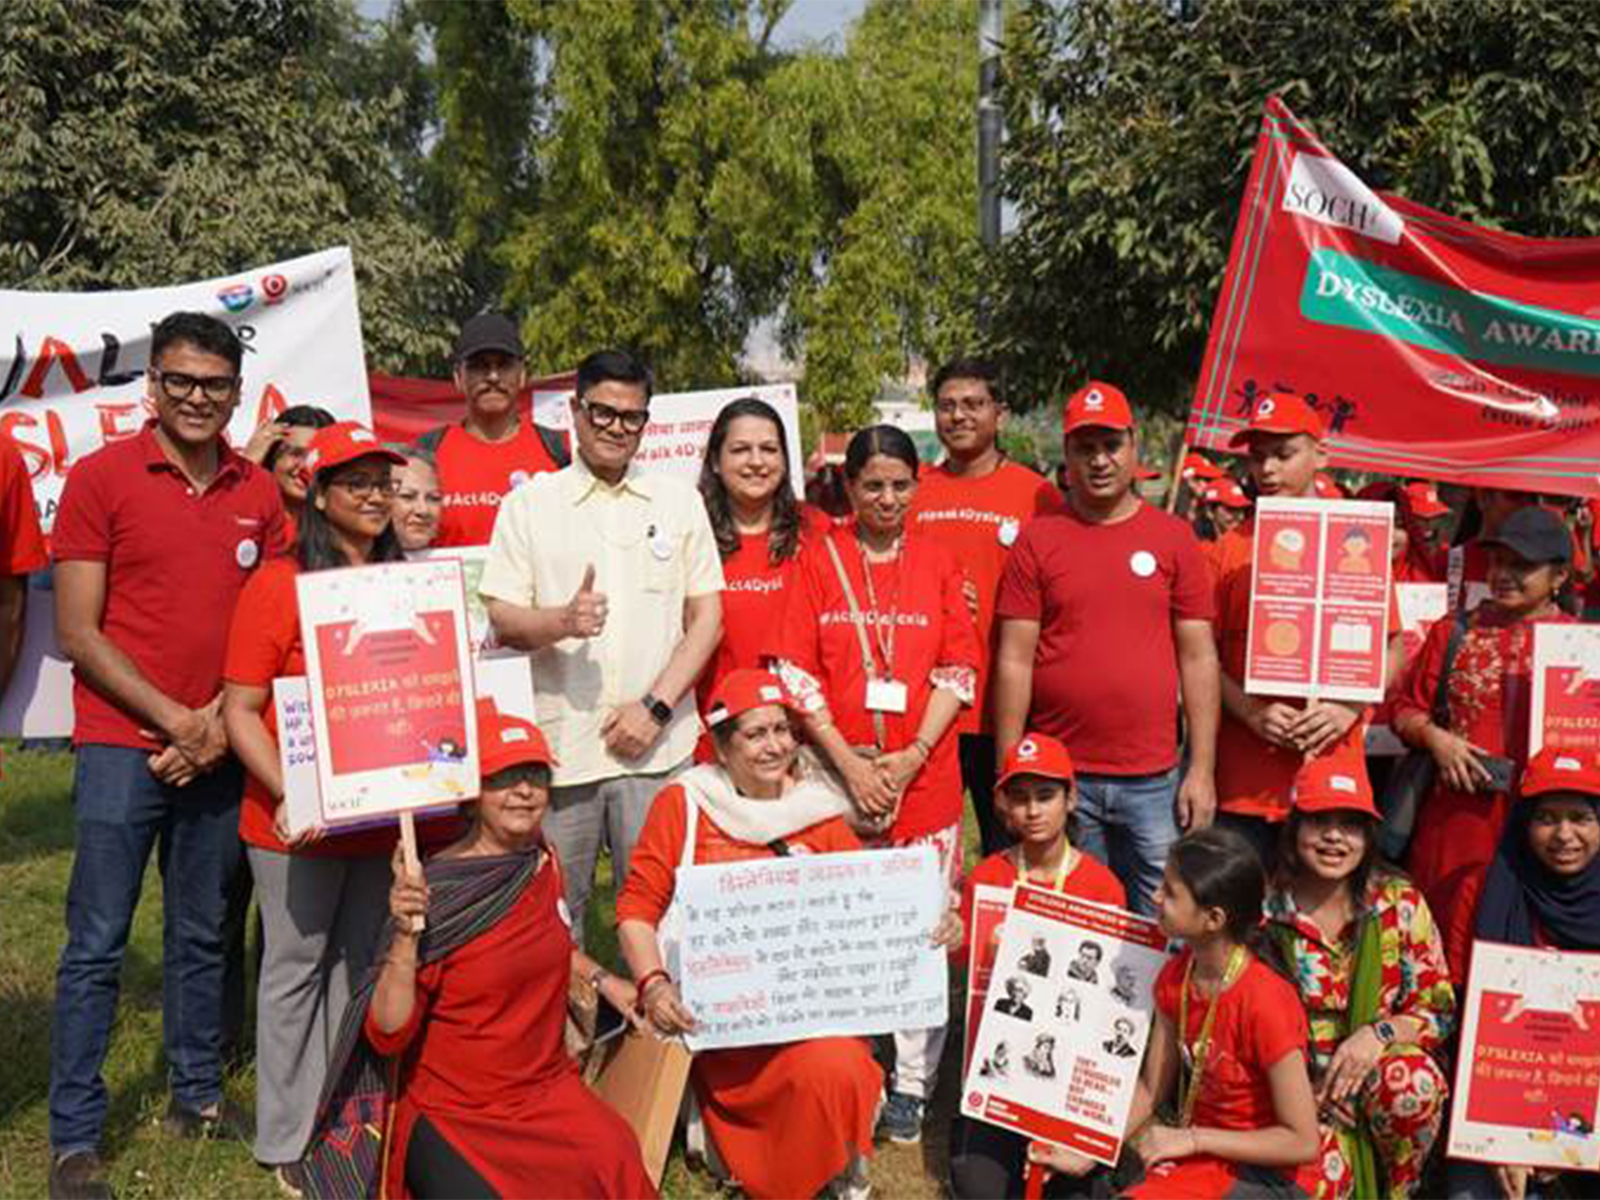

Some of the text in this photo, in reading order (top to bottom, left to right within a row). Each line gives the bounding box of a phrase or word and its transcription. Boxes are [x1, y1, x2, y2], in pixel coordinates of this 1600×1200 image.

[1286, 184, 1368, 230] SOCH
[1316, 270, 1600, 356] DYSLEXIA AWAR
[443, 490, 501, 507] #Act4D
